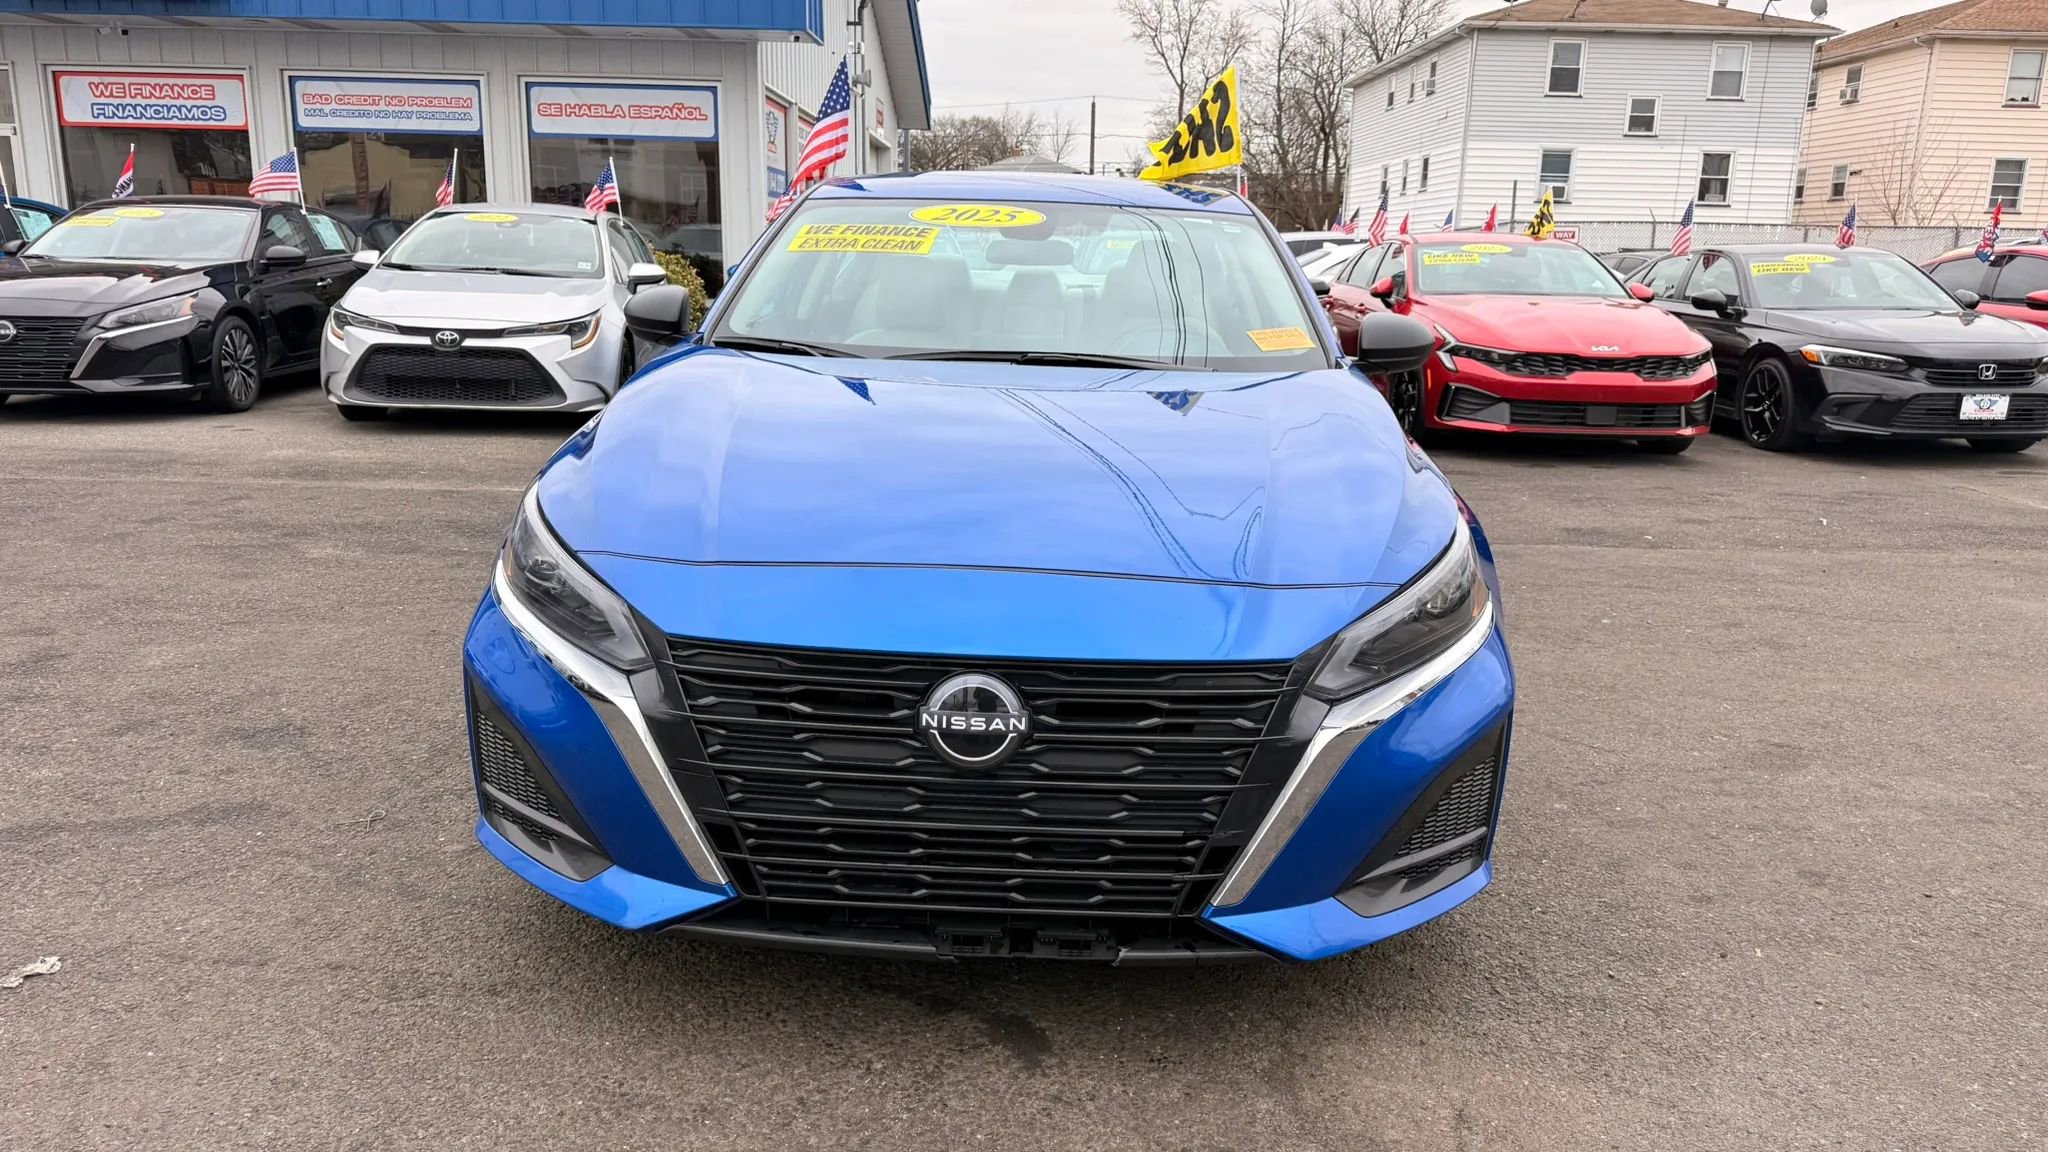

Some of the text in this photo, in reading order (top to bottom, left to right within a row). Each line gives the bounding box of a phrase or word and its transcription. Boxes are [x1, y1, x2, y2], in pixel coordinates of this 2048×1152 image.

[89, 82, 215, 100] WE FINANCE
[303, 94, 472, 108] BAD CREDIT NO PROBLEM
[92, 103, 226, 121] FINANCIAMOS
[304, 108, 472, 121] MAL CREDITO NO HAY PROBLEMA
[538, 102, 708, 120] SE HABLA ESPAÑOL
[934, 208, 1024, 222] 2025
[804, 225, 932, 238] WE FINANCE
[798, 238, 924, 251] EXTRA CLEAN
[922, 713, 1026, 731] NISSAN
